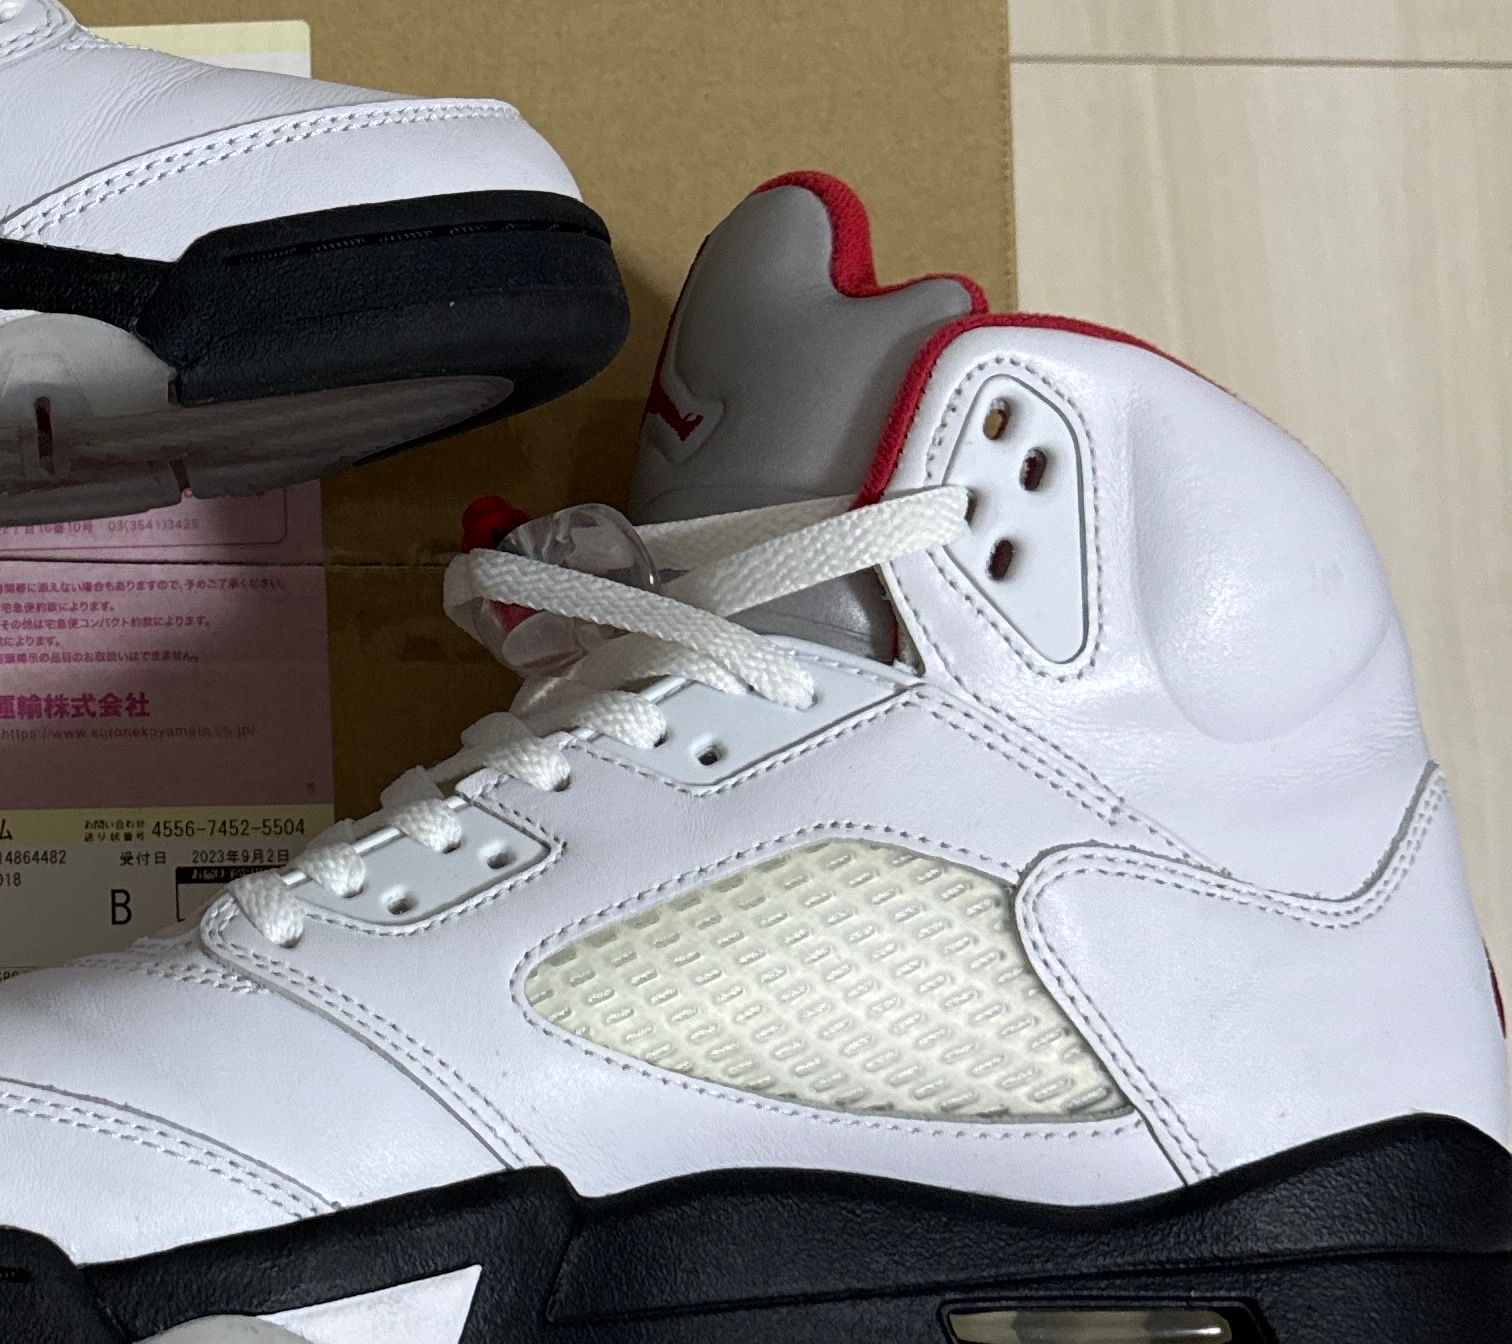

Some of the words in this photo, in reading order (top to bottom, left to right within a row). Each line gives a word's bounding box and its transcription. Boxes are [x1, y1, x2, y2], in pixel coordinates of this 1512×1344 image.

[151, 818, 306, 839] 4556-7452-5504
[119, 851, 167, 866] 受付日
[191, 848, 290, 865] 2023年9月2日
[110, 889, 132, 925] B
